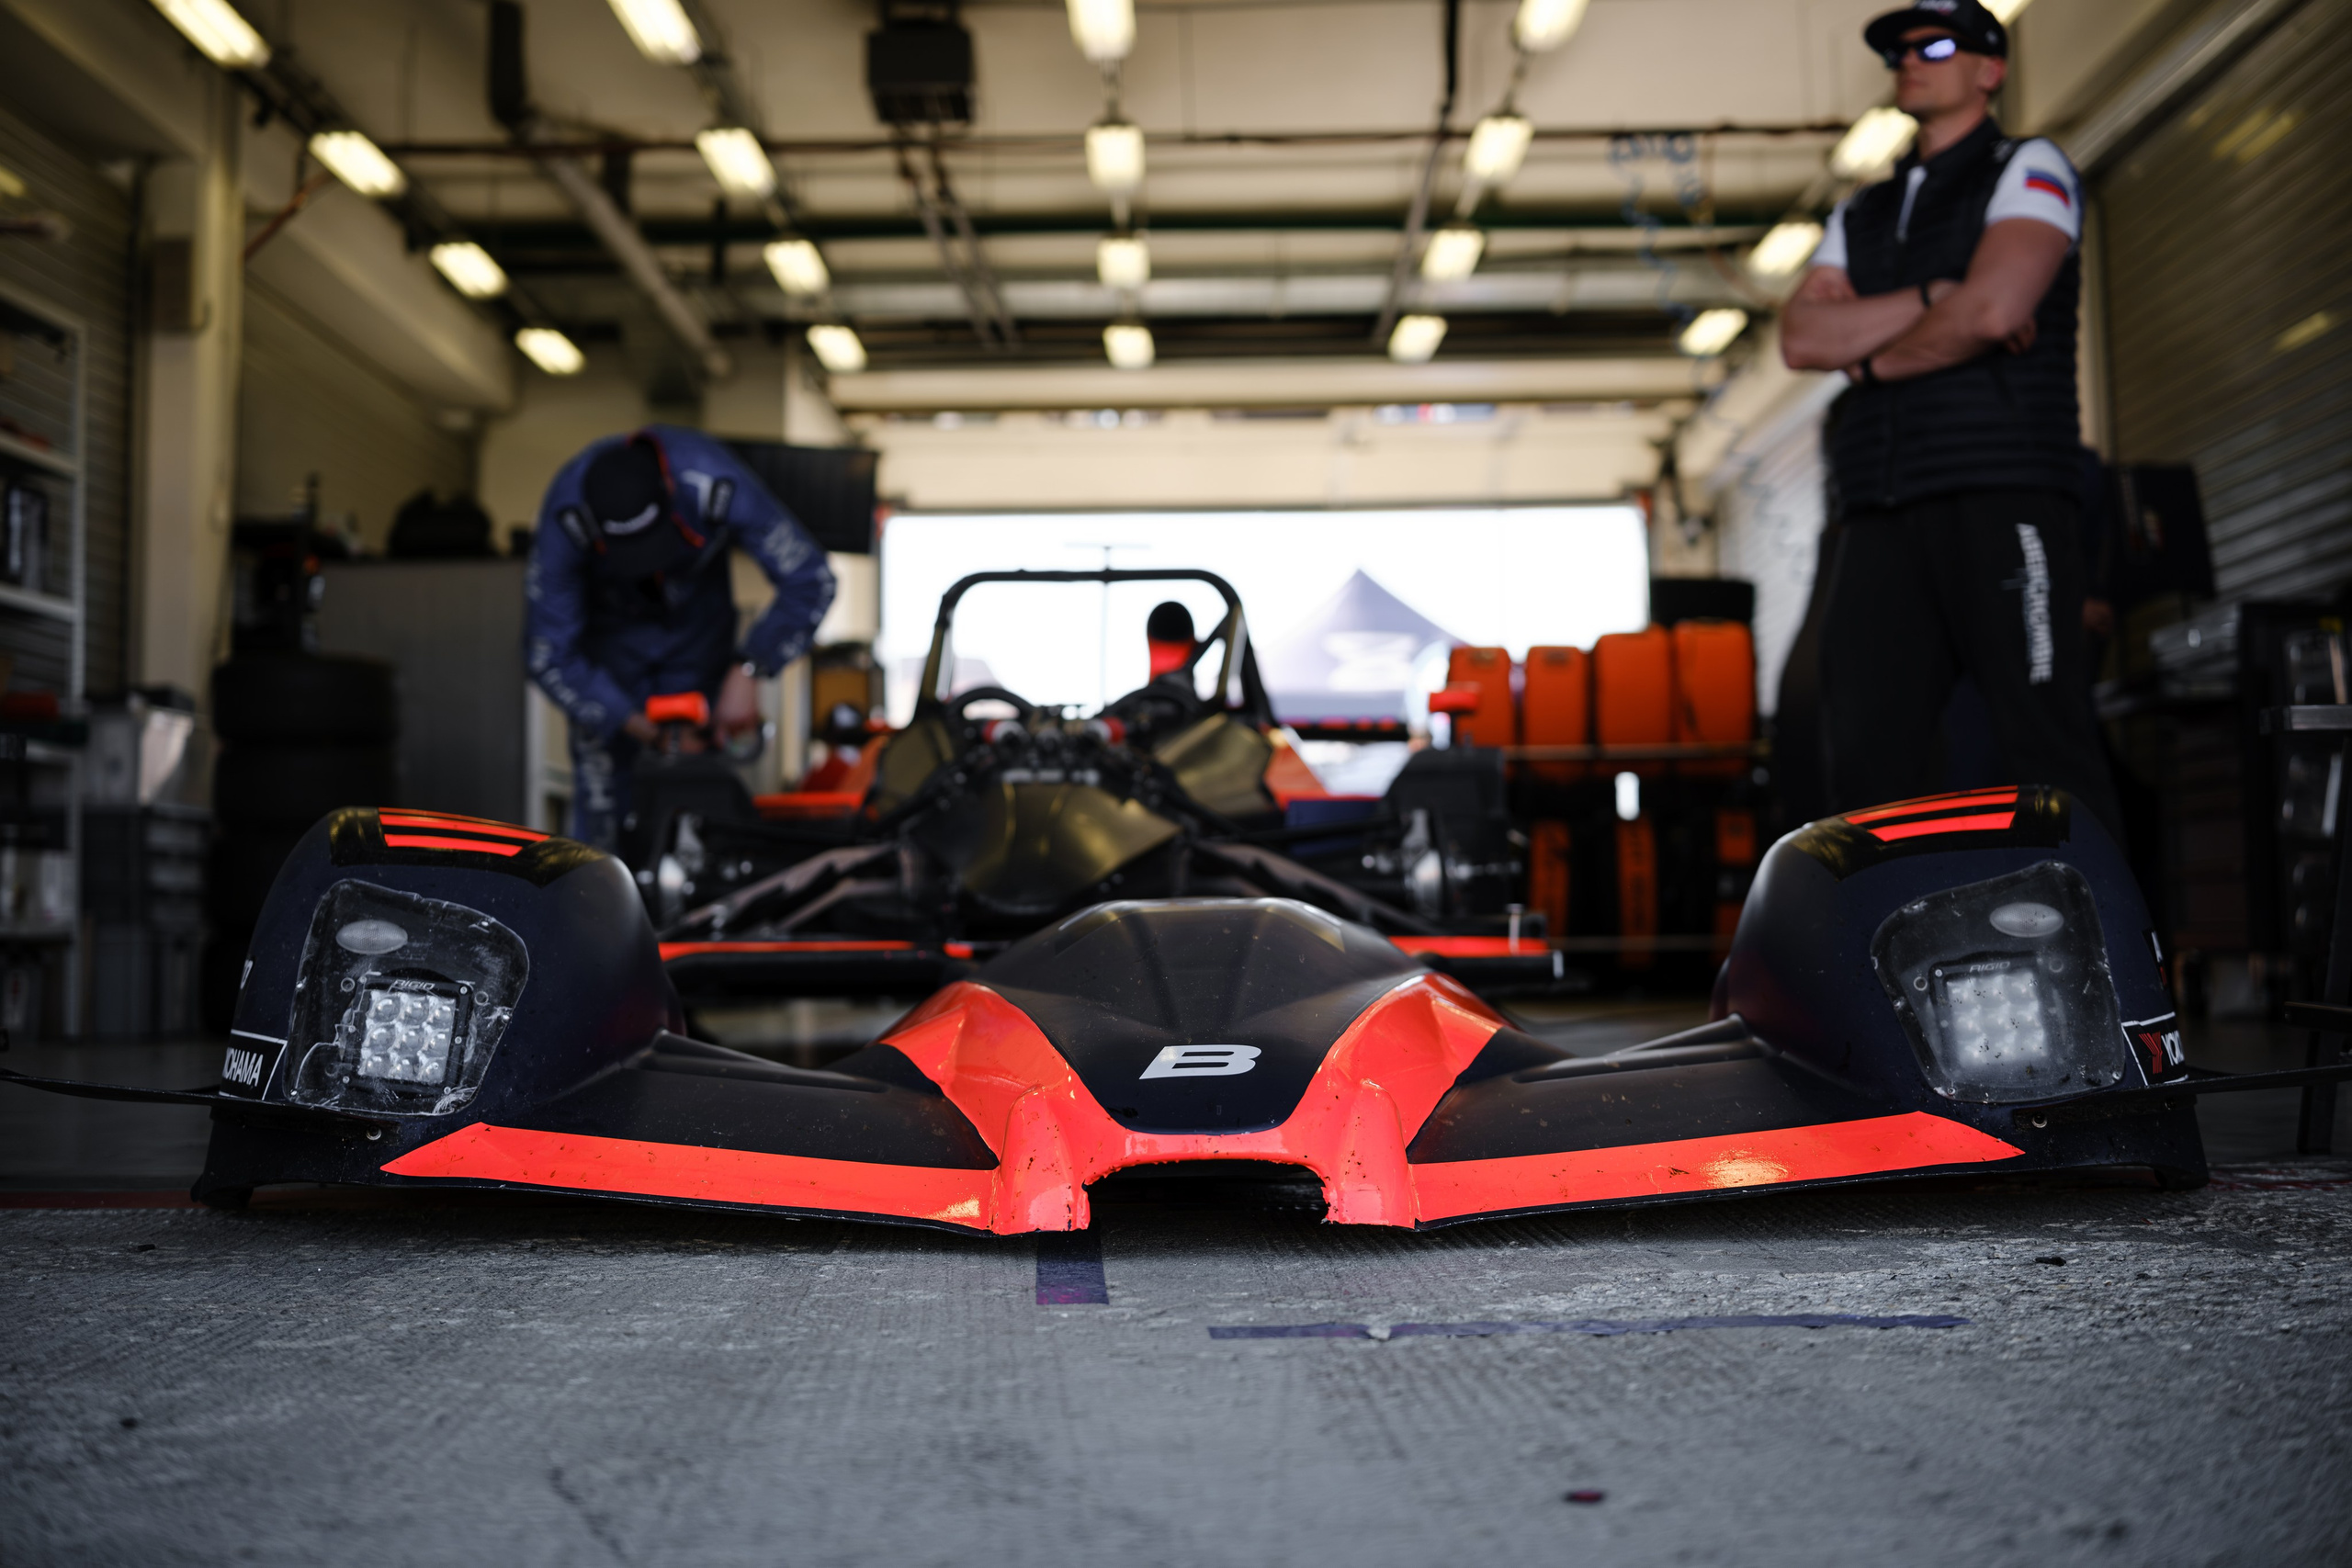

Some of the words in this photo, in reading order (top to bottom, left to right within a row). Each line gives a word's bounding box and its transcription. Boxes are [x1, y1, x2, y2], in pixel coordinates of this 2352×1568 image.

[1969, 961, 2010, 973] RIGID
[222, 1047, 264, 1087] OHAMA
[1139, 1044, 1262, 1079] B
